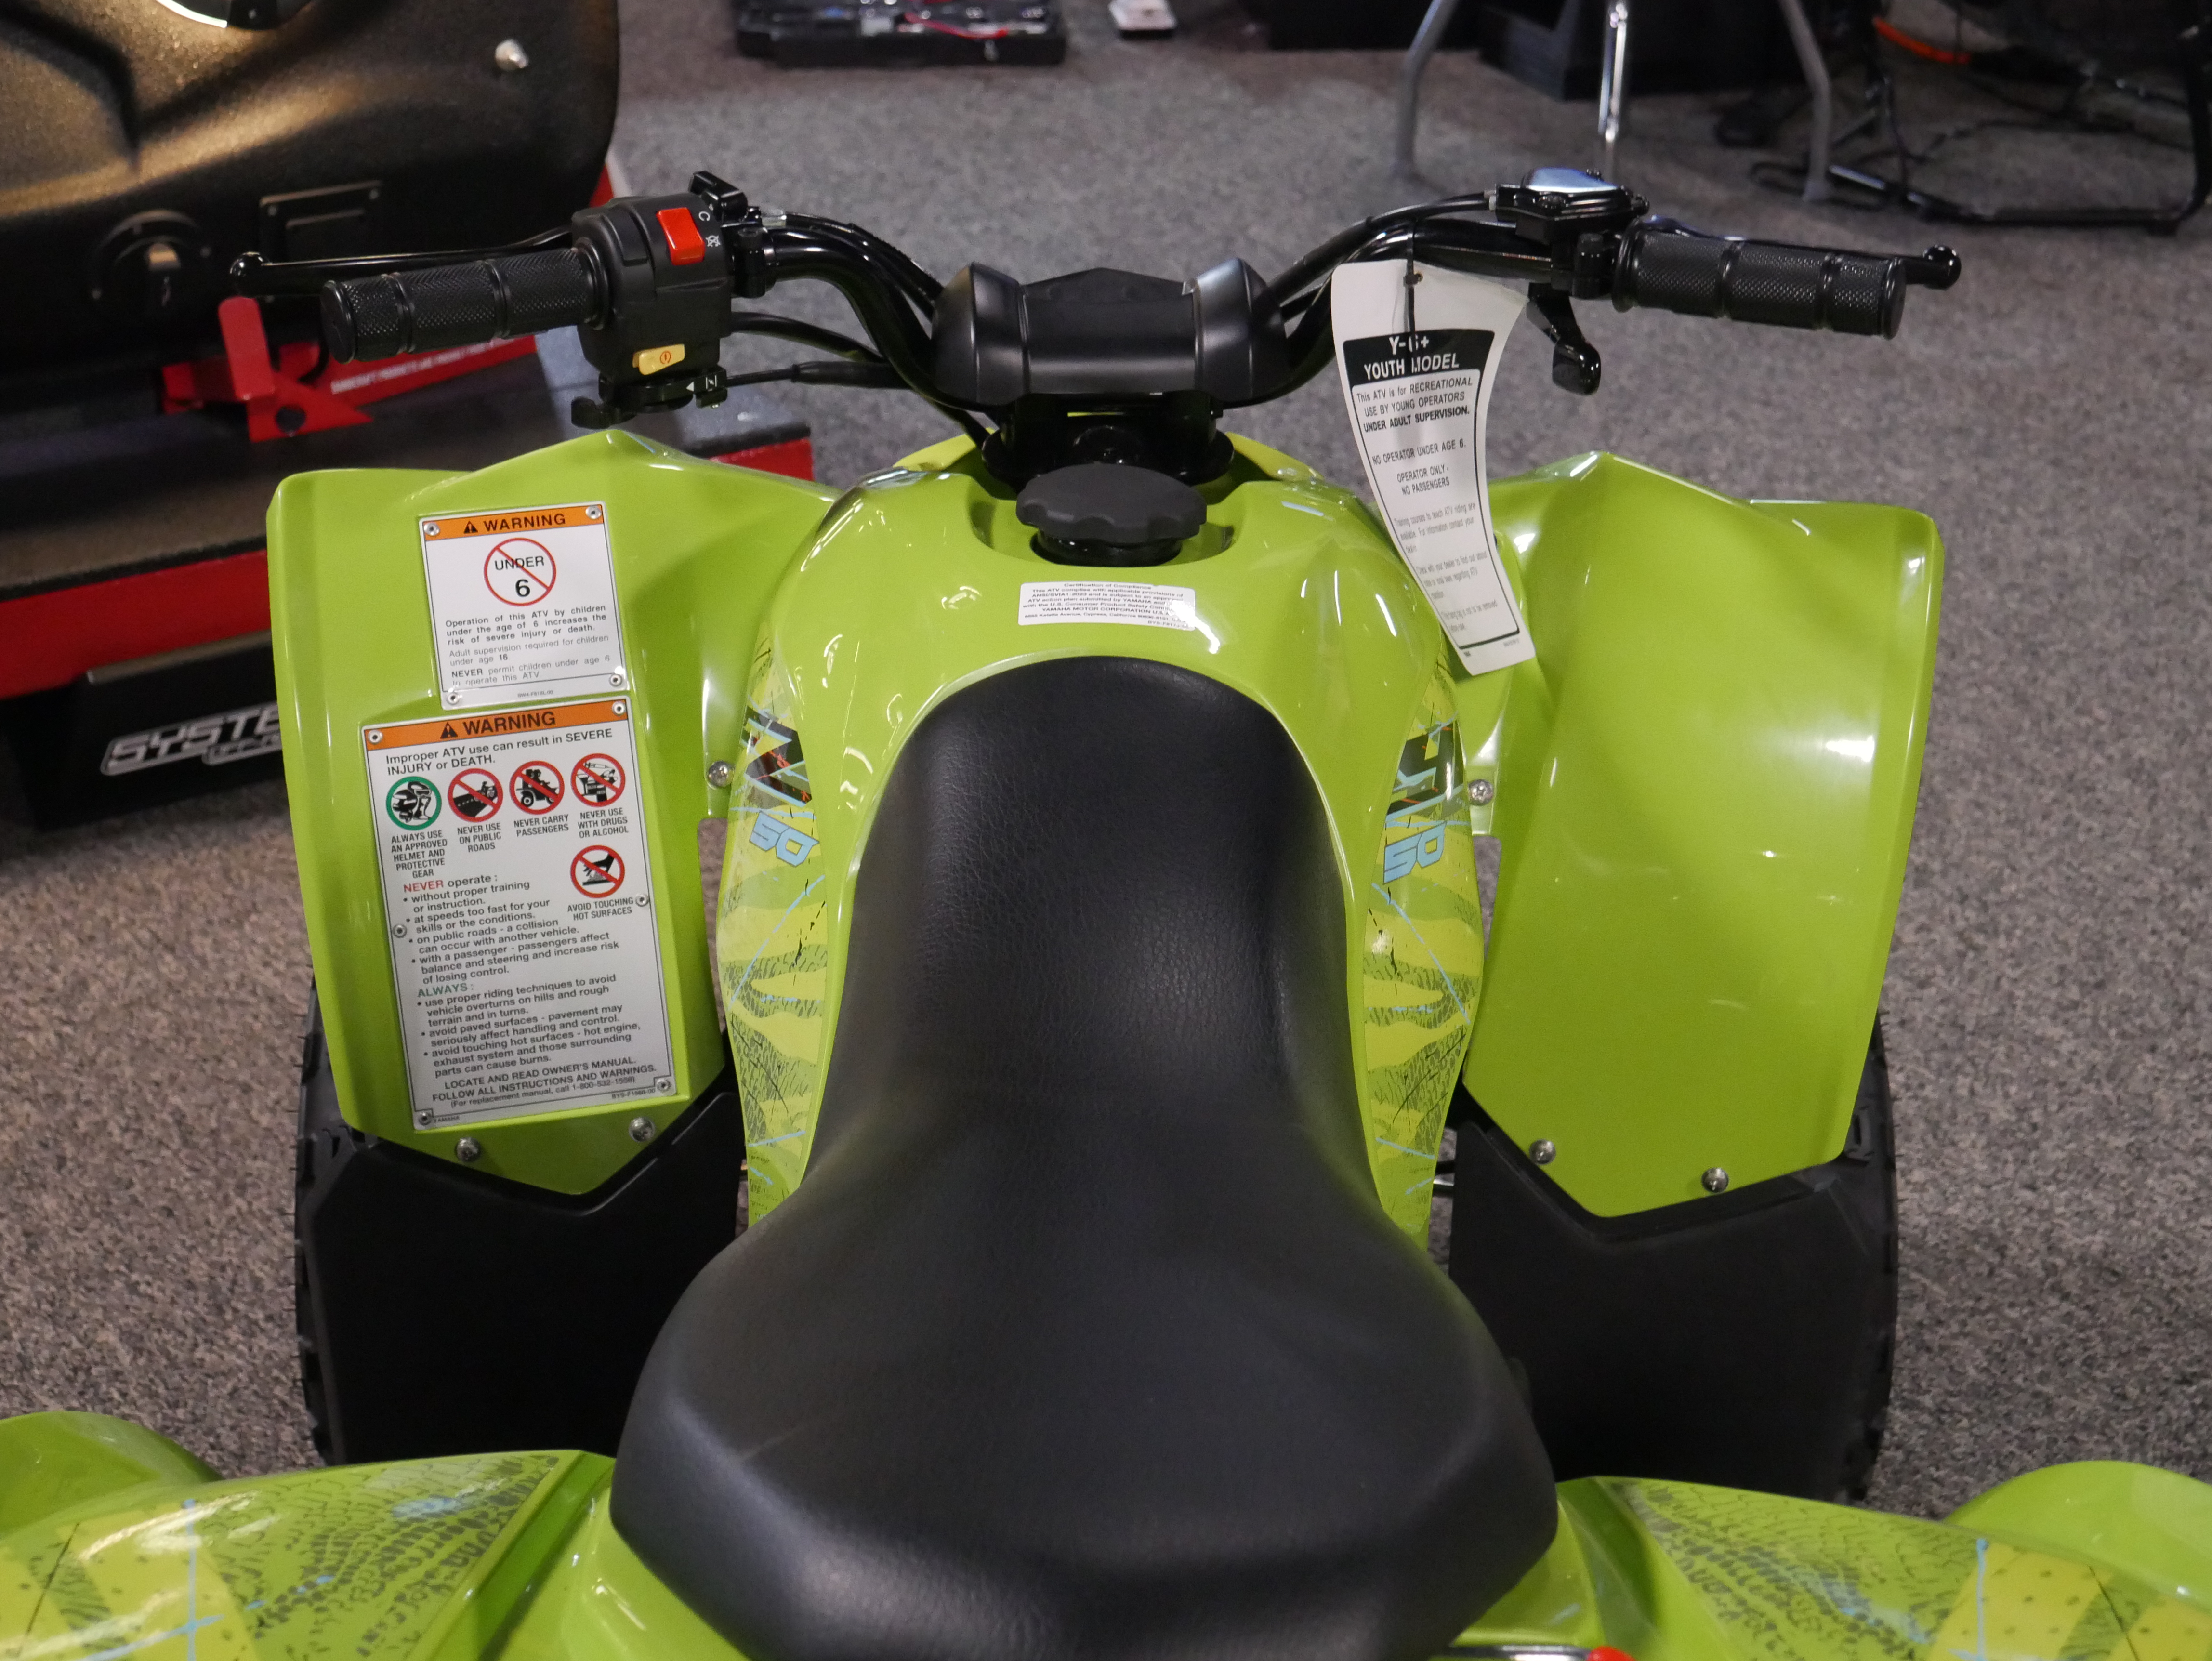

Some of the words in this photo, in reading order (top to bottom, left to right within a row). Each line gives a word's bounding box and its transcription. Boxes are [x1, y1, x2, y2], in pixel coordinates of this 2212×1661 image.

[1364, 358, 1405, 381] YOUTH
[1411, 353, 1460, 373] MODEL
[1357, 392, 1370, 403] This
[1373, 389, 1386, 401] ATV
[1389, 388, 1395, 397] is
[1397, 386, 1406, 396] for
[1409, 377, 1473, 394] RECREATIONAL
[1364, 406, 1378, 417] USE
[1380, 404, 1389, 415] BY
[1391, 399, 1415, 413] YOUNG
[1418, 391, 1465, 407] OPERATORS
[1363, 419, 1387, 433] UNDER
[1389, 415, 1411, 428] ADULT
[1415, 405, 1470, 423] SUPERVISION.
[1372, 455, 1382, 465] NO
[1382, 448, 1415, 463] OPERATOR
[1417, 443, 1439, 456] UNDER
[1441, 439, 1456, 451] AGE
[1397, 467, 1428, 483] OPERATOR
[1401, 485, 1410, 496] NO
[1412, 476, 1450, 494] PASSENGERS
[483, 513, 566, 532] WARNING
[494, 556, 544, 571] UNDER
[515, 579, 530, 597] 6
[445, 618, 488, 628] Operation
[531, 610, 548, 619] ATV
[554, 609, 565, 617] by
[571, 605, 606, 614] children
[447, 628, 472, 636] under
[496, 624, 512, 633] age
[545, 617, 588, 626] increases
[448, 637, 464, 646] risk
[486, 633, 515, 642] severe
[521, 630, 546, 639] injury
[449, 649, 471, 657] Adult
[474, 645, 521, 656] supervision
[525, 639, 559, 650] required
[576, 635, 609, 644] children
[450, 658, 473, 666] under
[478, 657, 494, 665] age
[451, 668, 483, 678] NEVER
[488, 665, 514, 676] permit
[518, 662, 551, 671] children
[555, 659, 579, 667] under
[465, 676, 498, 686] operate
[462, 711, 556, 736] WARNING
[386, 751, 439, 765] Improper
[443, 746, 465, 757] ATV
[469, 745, 489, 754] use
[493, 742, 514, 751] can
[516, 737, 549, 748] result
[553, 735, 562, 744] in
[566, 728, 613, 743] SEVERE
[387, 762, 432, 776] INJURY
[436, 762, 448, 770] or
[451, 754, 495, 768] DEATH.
[514, 817, 540, 828] NEVER
[542, 814, 569, 824] CARRY
[580, 809, 606, 819] NEVER
[608, 807, 623, 817] USE
[457, 825, 484, 835] NEVER
[485, 822, 501, 831] USE
[516, 823, 569, 837] PASSENGERS
[578, 819, 598, 829] WITH
[600, 816, 628, 827] DRUGS
[391, 832, 425, 844] ALWAYS
[427, 830, 443, 839] USE
[459, 835, 471, 844] ON
[473, 831, 501, 843] PUBLIC
[579, 830, 590, 838] OR
[592, 826, 629, 837] ALCOHOL
[391, 844, 403, 853] AN
[405, 839, 448, 851] APPROVED
[467, 842, 495, 853] ROADS
[393, 850, 425, 862] HELMET
[428, 848, 445, 857] AND
[395, 857, 445, 871] PROTECTIVE
[412, 869, 434, 879] GEAR
[403, 880, 444, 893] NEVER
[411, 891, 450, 903] without
[453, 887, 488, 899] proper
[490, 882, 530, 893] training
[414, 915, 424, 923] at
[427, 910, 465, 923] speeds
[467, 908, 485, 916] too
[487, 904, 507, 914] fast
[510, 902, 524, 911] for
[527, 900, 550, 910] your
[427, 898, 486, 911] instruction.
[567, 902, 592, 912] AVOID
[594, 896, 634, 909] TOUCHING
[573, 911, 589, 921] HOT
[591, 906, 632, 919] SURFACES
[416, 922, 443, 934] skills
[459, 919, 476, 928] the
[478, 912, 535, 925] conditions.
[425, 999, 444, 1007] use
[446, 993, 481, 1006] proper
[484, 989, 514, 999] riding
[516, 981, 573, 995] techniques
[589, 973, 616, 985] avoid
[444, 1077, 485, 1090] LOCATE
[487, 1073, 509, 1084] AND
[512, 1069, 540, 1081] READ
[541, 1062, 589, 1076] OWNER'S
[591, 1057, 636, 1069] MANUAL.
[432, 1089, 474, 1102] FOLLOW
[477, 1086, 496, 1096] ALL
[499, 1075, 574, 1093] INSTRUCTIONS
[576, 1072, 597, 1082] AND
[599, 1064, 657, 1079] WARNINGS.
